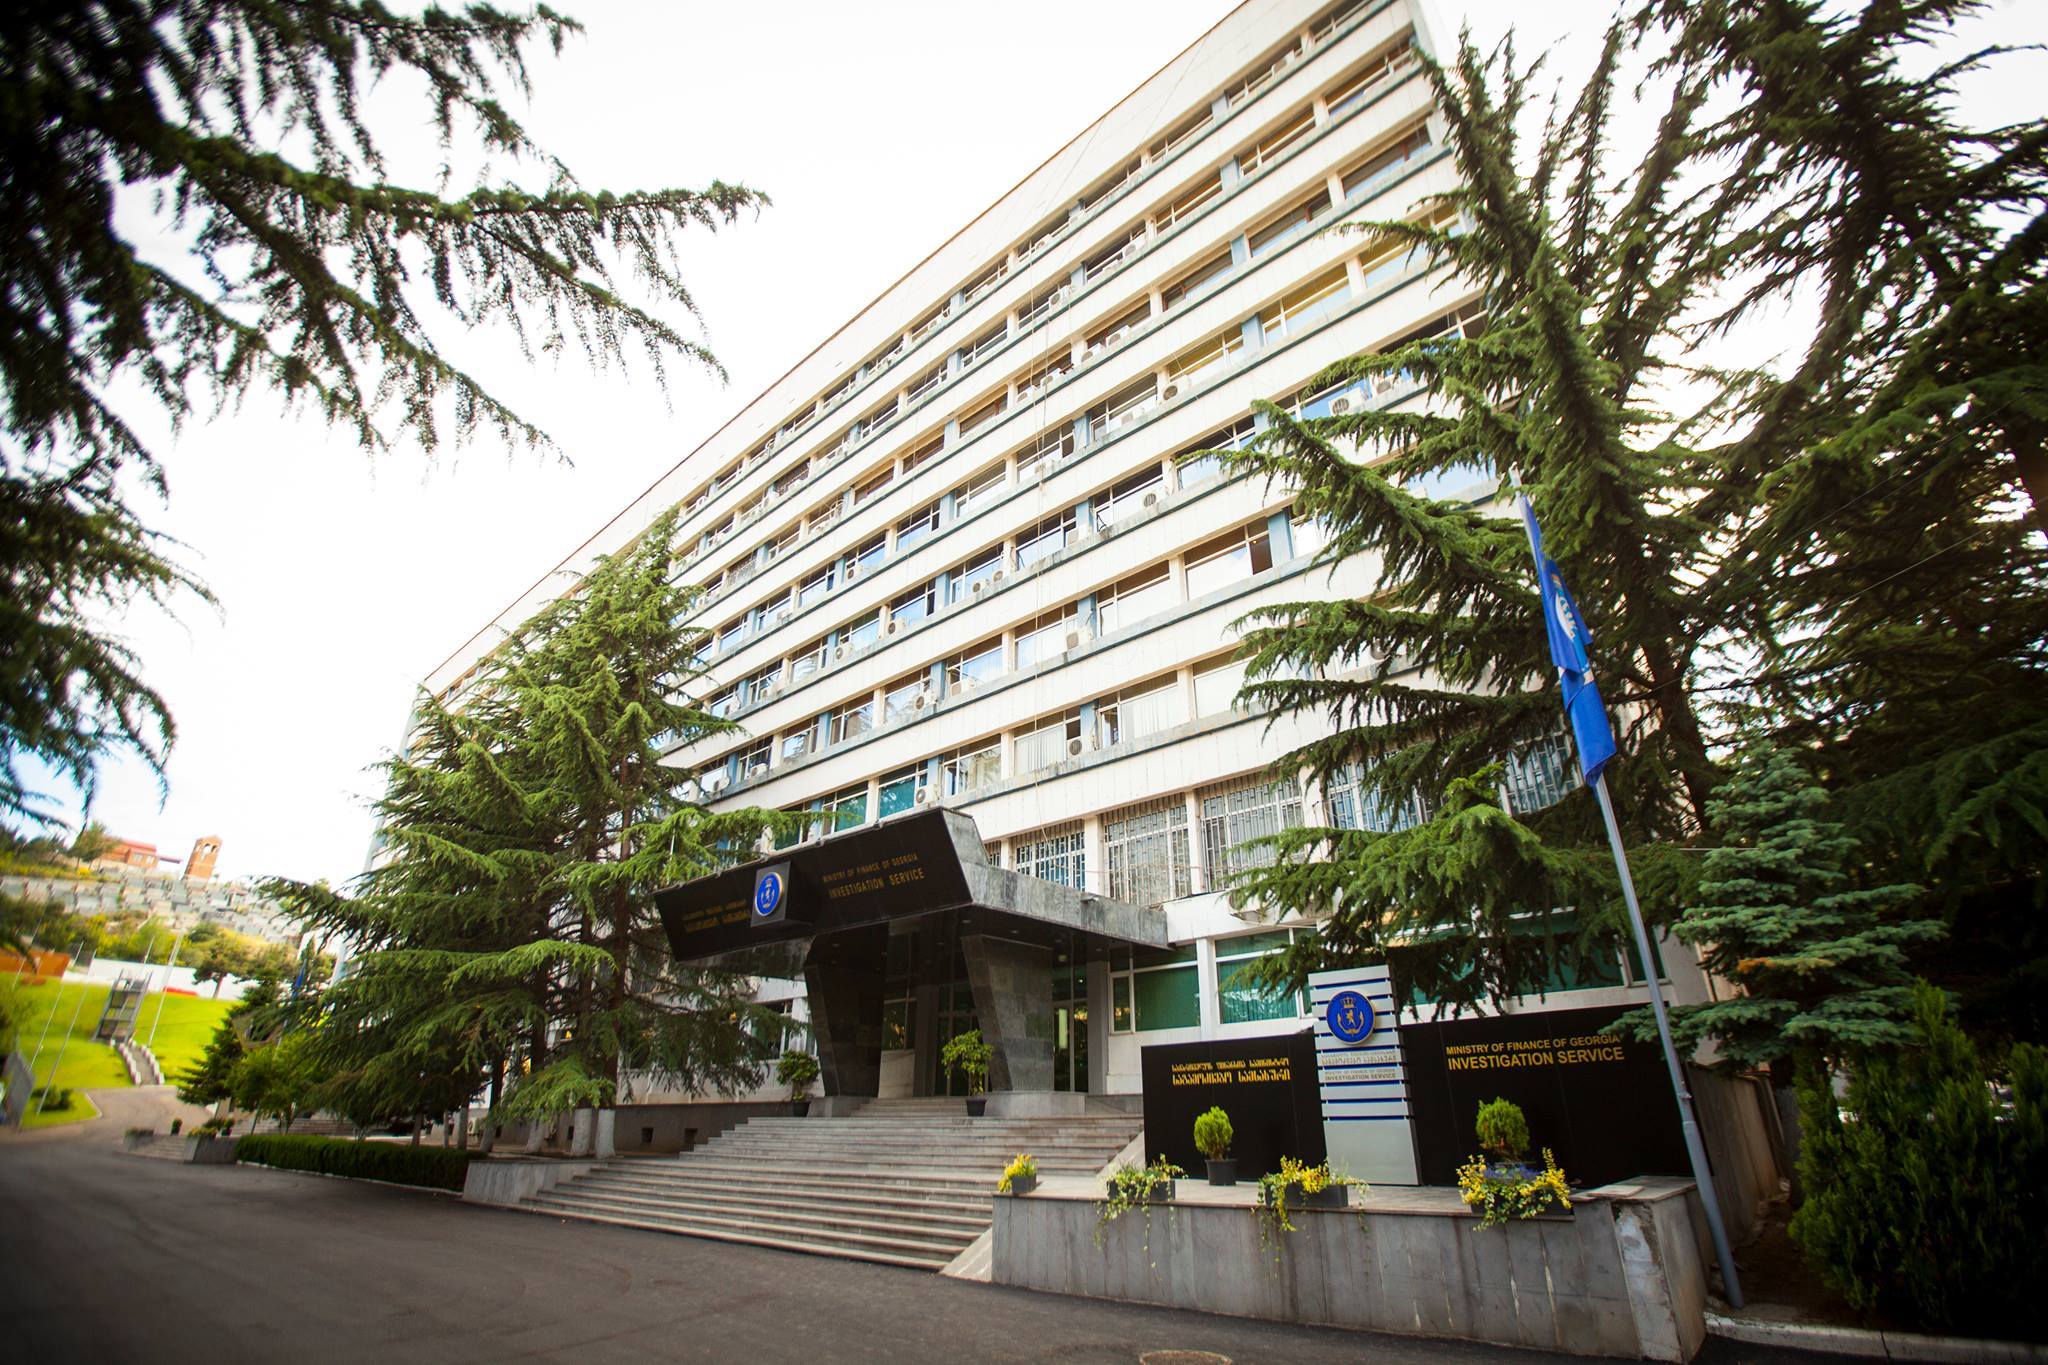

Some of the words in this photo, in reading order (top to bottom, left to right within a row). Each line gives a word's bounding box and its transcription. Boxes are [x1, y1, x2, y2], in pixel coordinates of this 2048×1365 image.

[828, 877, 885, 897] INVESTIGATION
[889, 868, 925, 885] SERVICE
[1446, 1045, 1489, 1055] MINISTRY
[1491, 1043, 1504, 1052] OF
[1507, 1039, 1550, 1051] FINANCE
[1552, 1038, 1567, 1048] OF
[1569, 1035, 1620, 1046] GEORGIA
[1448, 1052, 1553, 1070] INVESTIGATION
[1557, 1047, 1625, 1064] SERVICE
